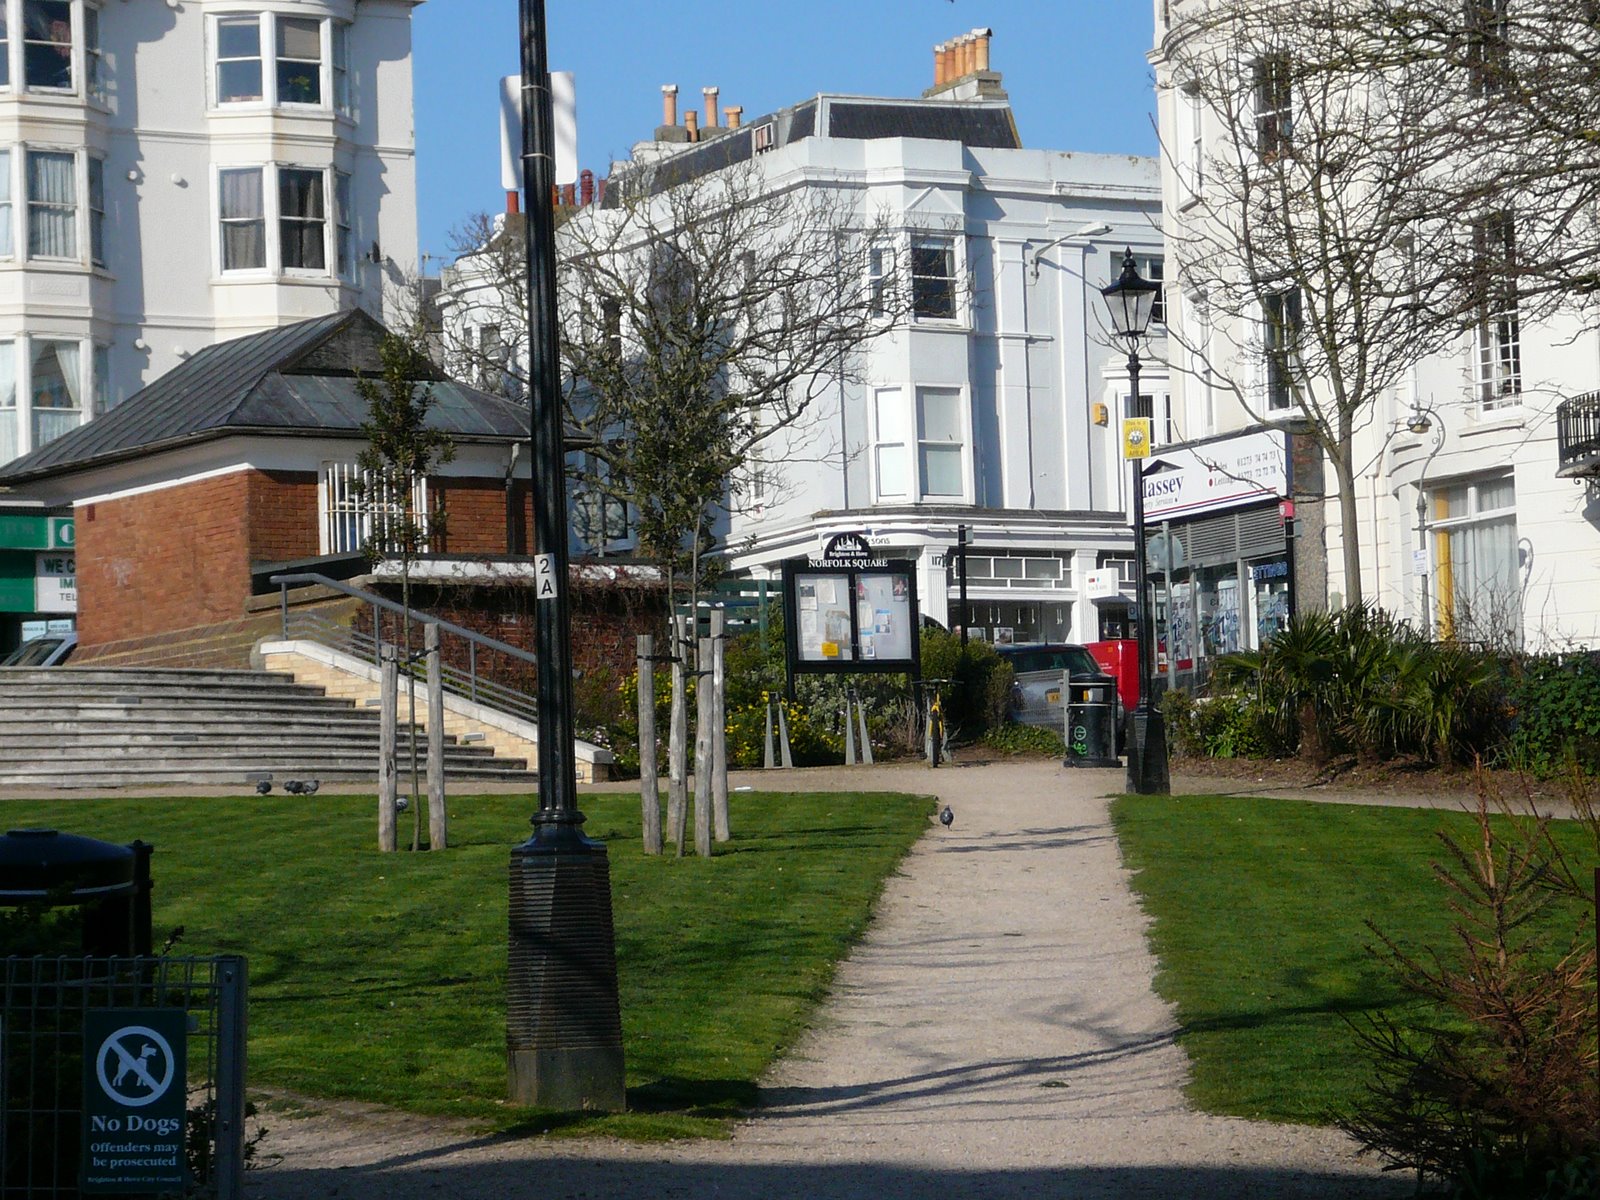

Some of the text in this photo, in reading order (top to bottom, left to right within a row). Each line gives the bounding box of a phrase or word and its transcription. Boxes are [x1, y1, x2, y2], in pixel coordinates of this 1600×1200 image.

[870, 537, 890, 545] sons
[43, 558, 63, 573] WE
[540, 558, 550, 574] 2
[808, 559, 888, 569] NORFOLK SQUARE
[541, 579, 553, 595] A
[91, 1115, 180, 1136] No Dogs
[90, 1142, 179, 1154] Offenders may
[93, 1155, 176, 1169] be prosecuted
